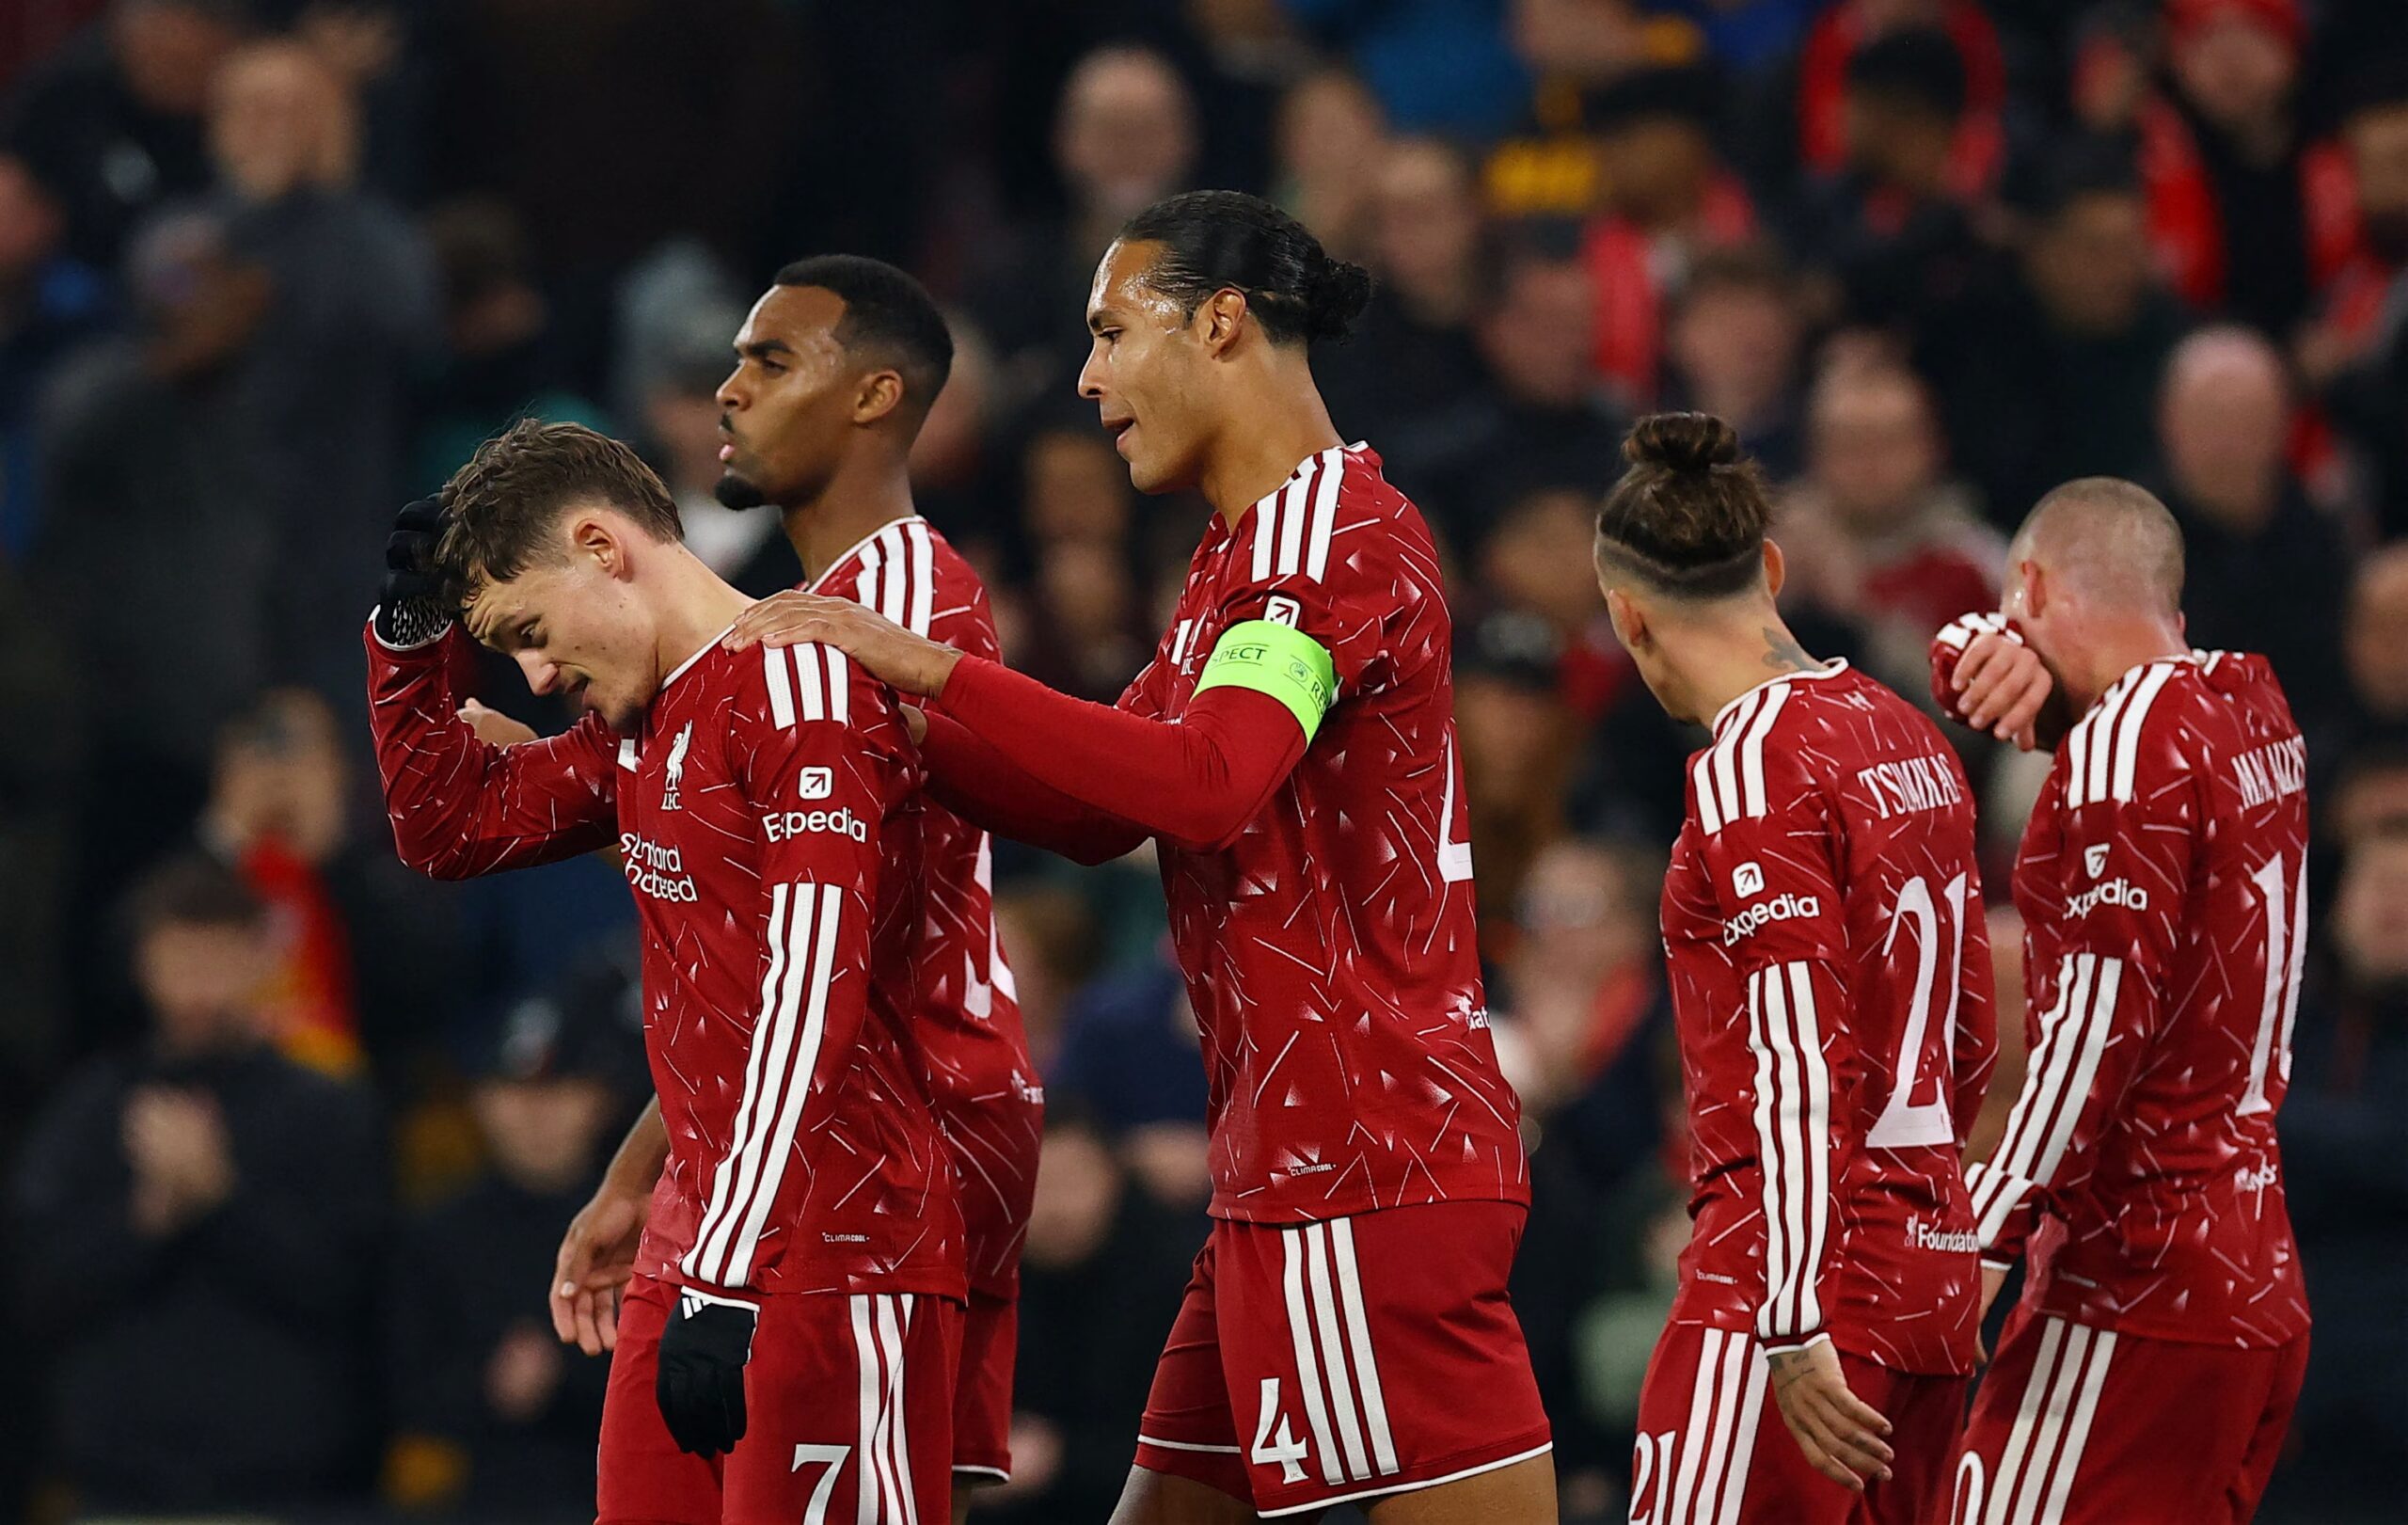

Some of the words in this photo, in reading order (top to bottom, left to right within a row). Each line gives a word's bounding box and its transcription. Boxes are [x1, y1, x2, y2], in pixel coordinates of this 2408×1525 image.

[1865, 871, 1967, 1149] 21
[1251, 1377, 1309, 1485] 4
[1628, 1430, 1677, 1525] 21
[790, 1443, 852, 1525] 7
